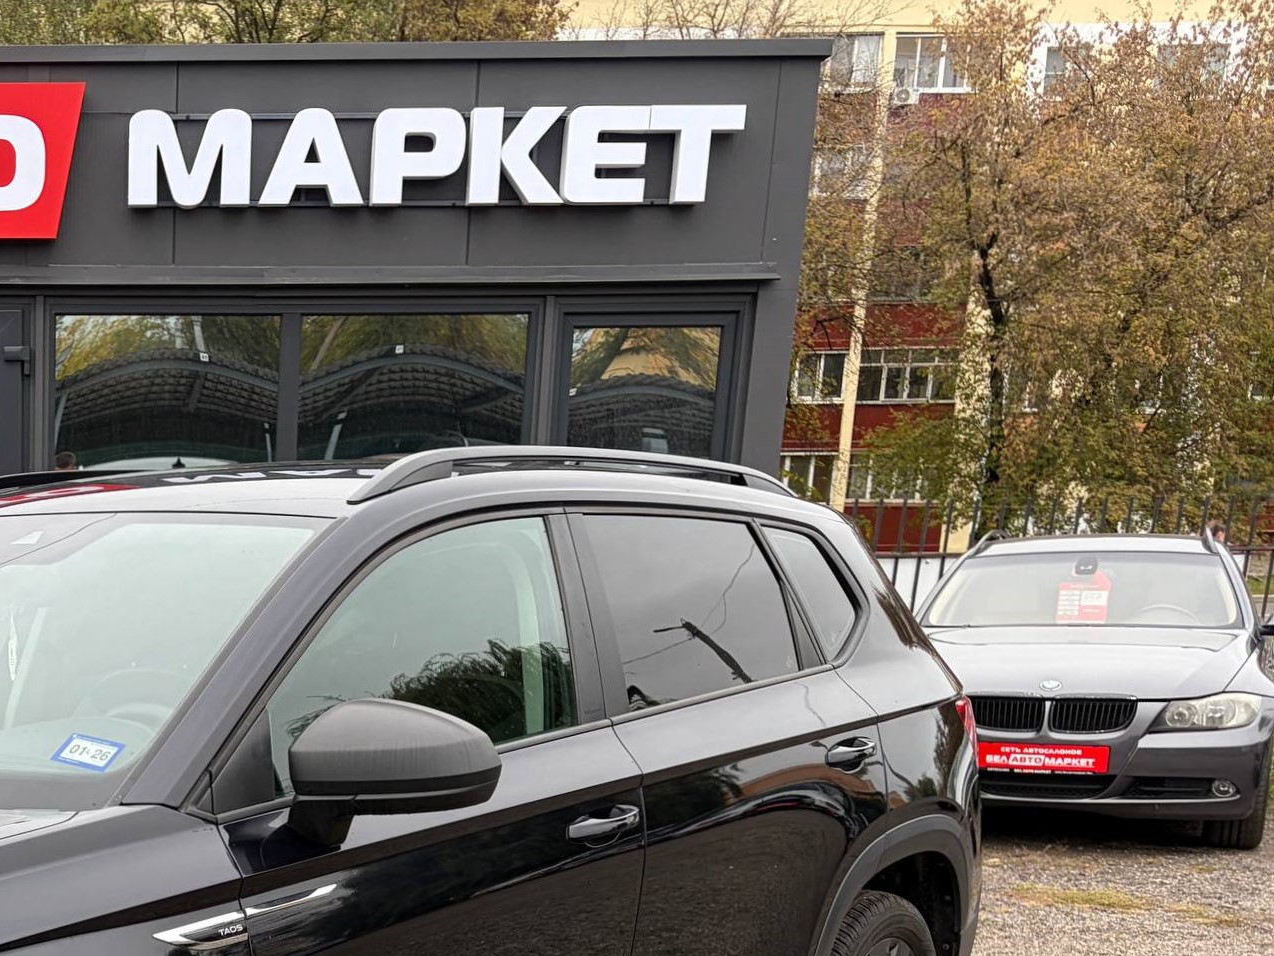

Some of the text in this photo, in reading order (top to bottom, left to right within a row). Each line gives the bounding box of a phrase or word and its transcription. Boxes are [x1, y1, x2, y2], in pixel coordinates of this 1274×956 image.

[128, 104, 747, 209] МАРКЕТ
[986, 755, 1096, 767] БЕЛ АВТО МАРКЕТ
[218, 924, 244, 936] TAOS
